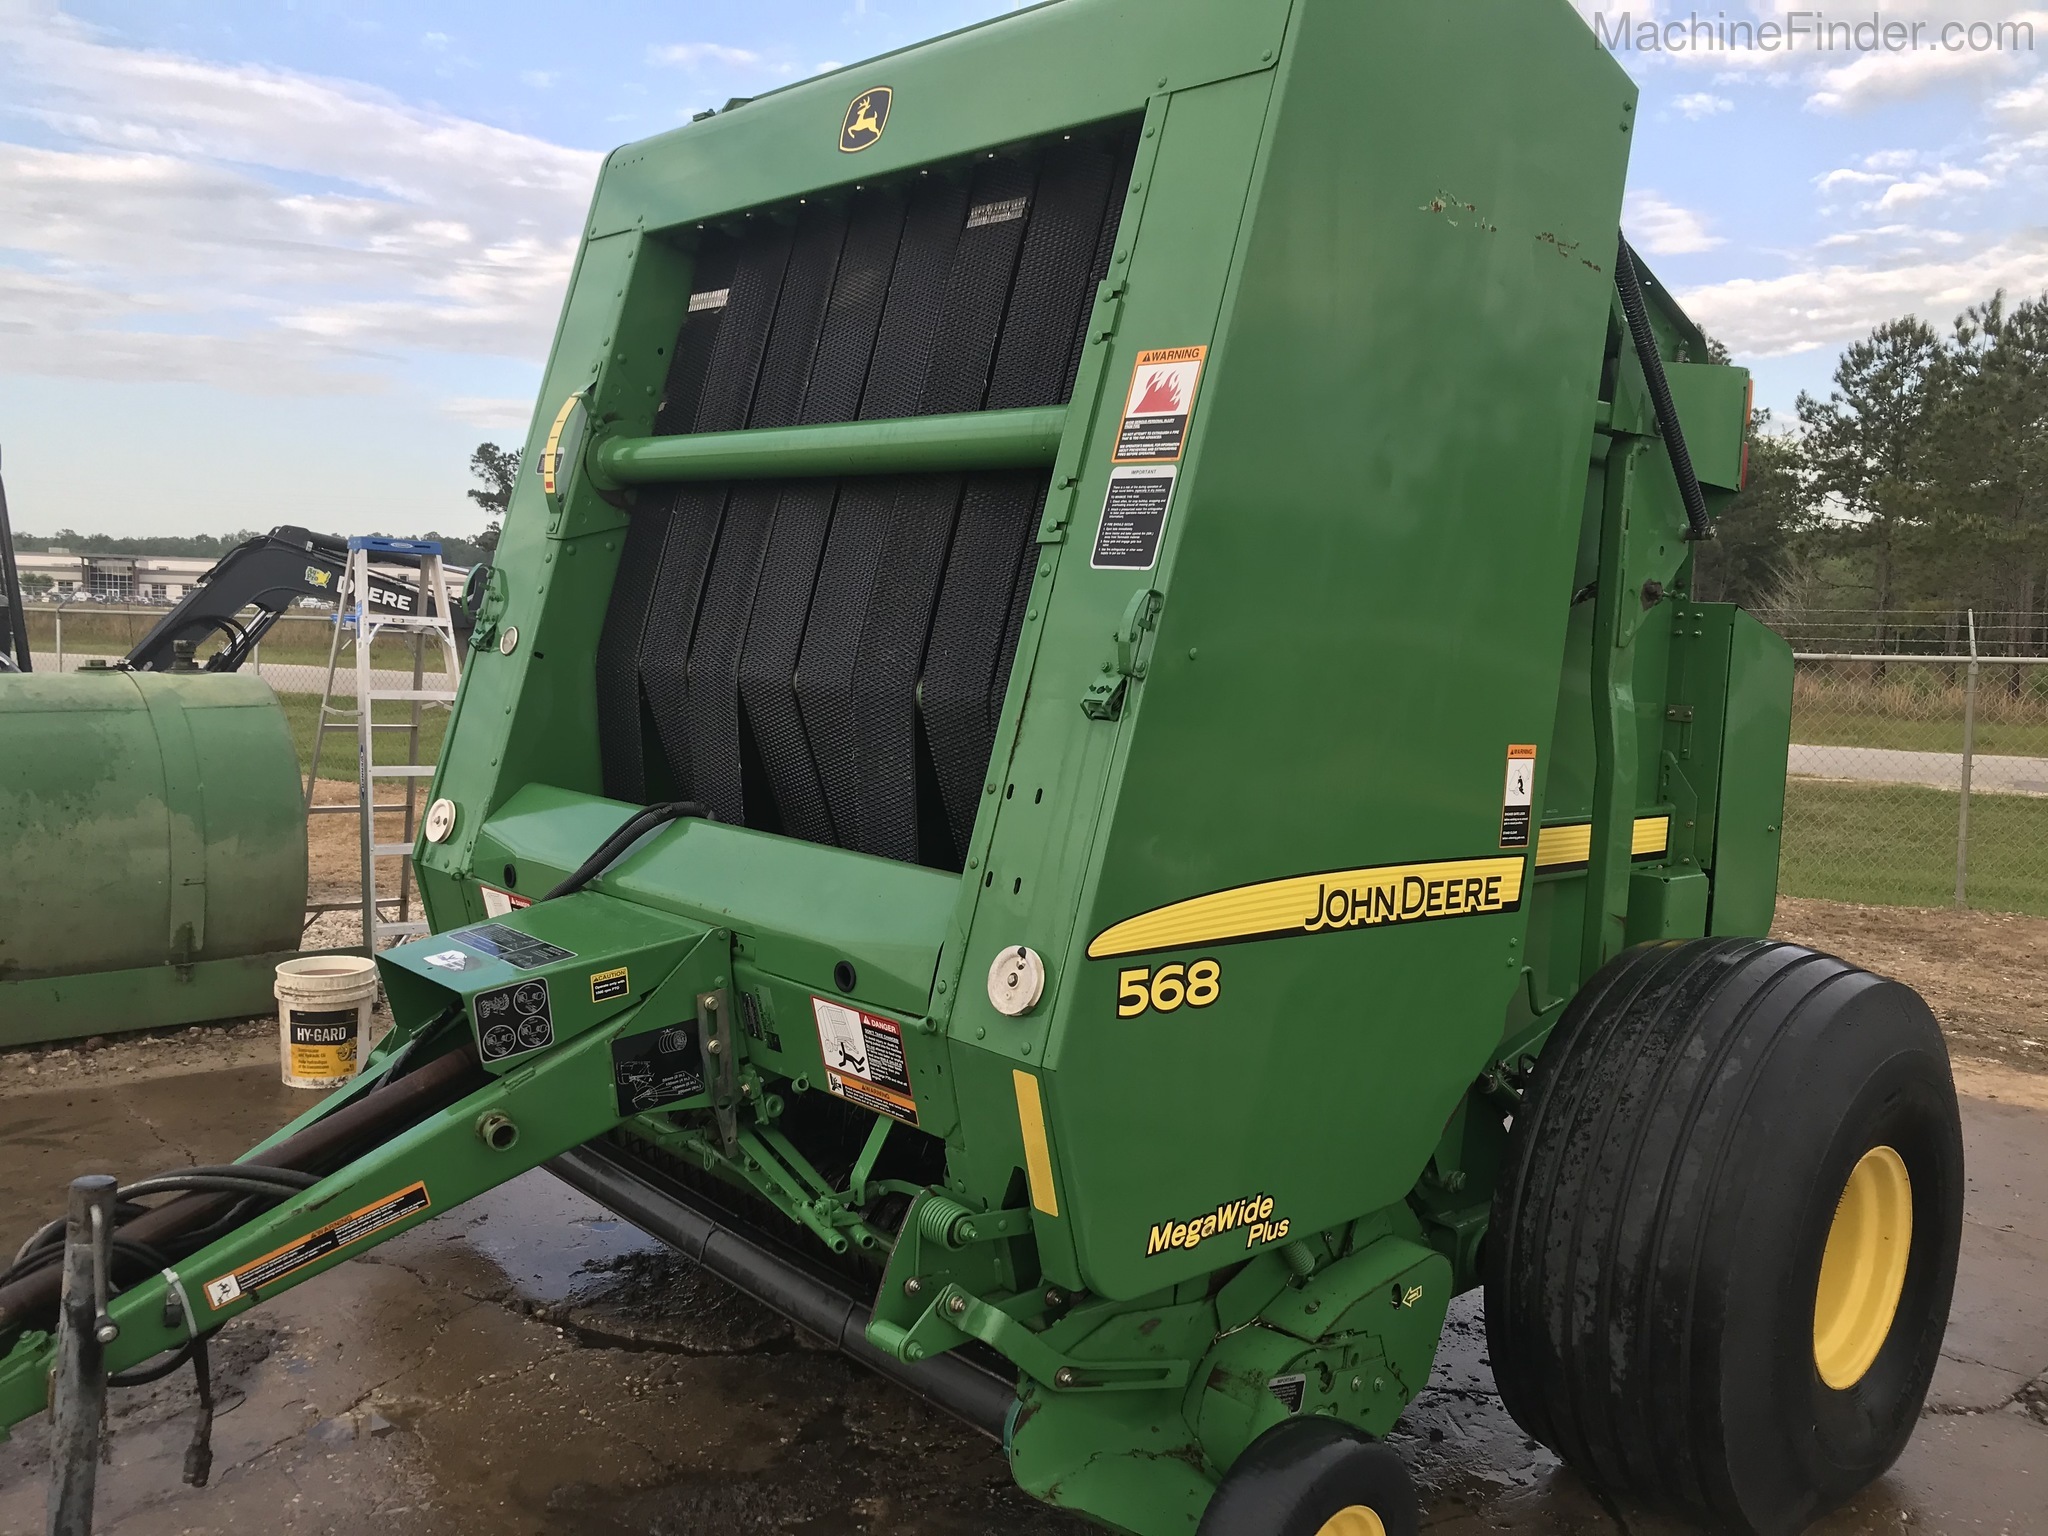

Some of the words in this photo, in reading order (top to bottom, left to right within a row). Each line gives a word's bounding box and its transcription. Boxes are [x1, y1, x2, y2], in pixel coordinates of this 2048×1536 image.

[1151, 348, 1200, 362] WARNING
[336, 575, 412, 611] DERE
[1304, 882, 1396, 930] JOHN
[1400, 874, 1503, 921] DEERE
[599, 970, 625, 981] CAUTION
[1116, 957, 1222, 1019] 568
[297, 1027, 346, 1042] HY-GARD
[871, 1019, 896, 1033] DANGER
[315, 1214, 353, 1235] WARNING
[1145, 1191, 1275, 1258] MegaWide
[1245, 1217, 1291, 1250] Plus
